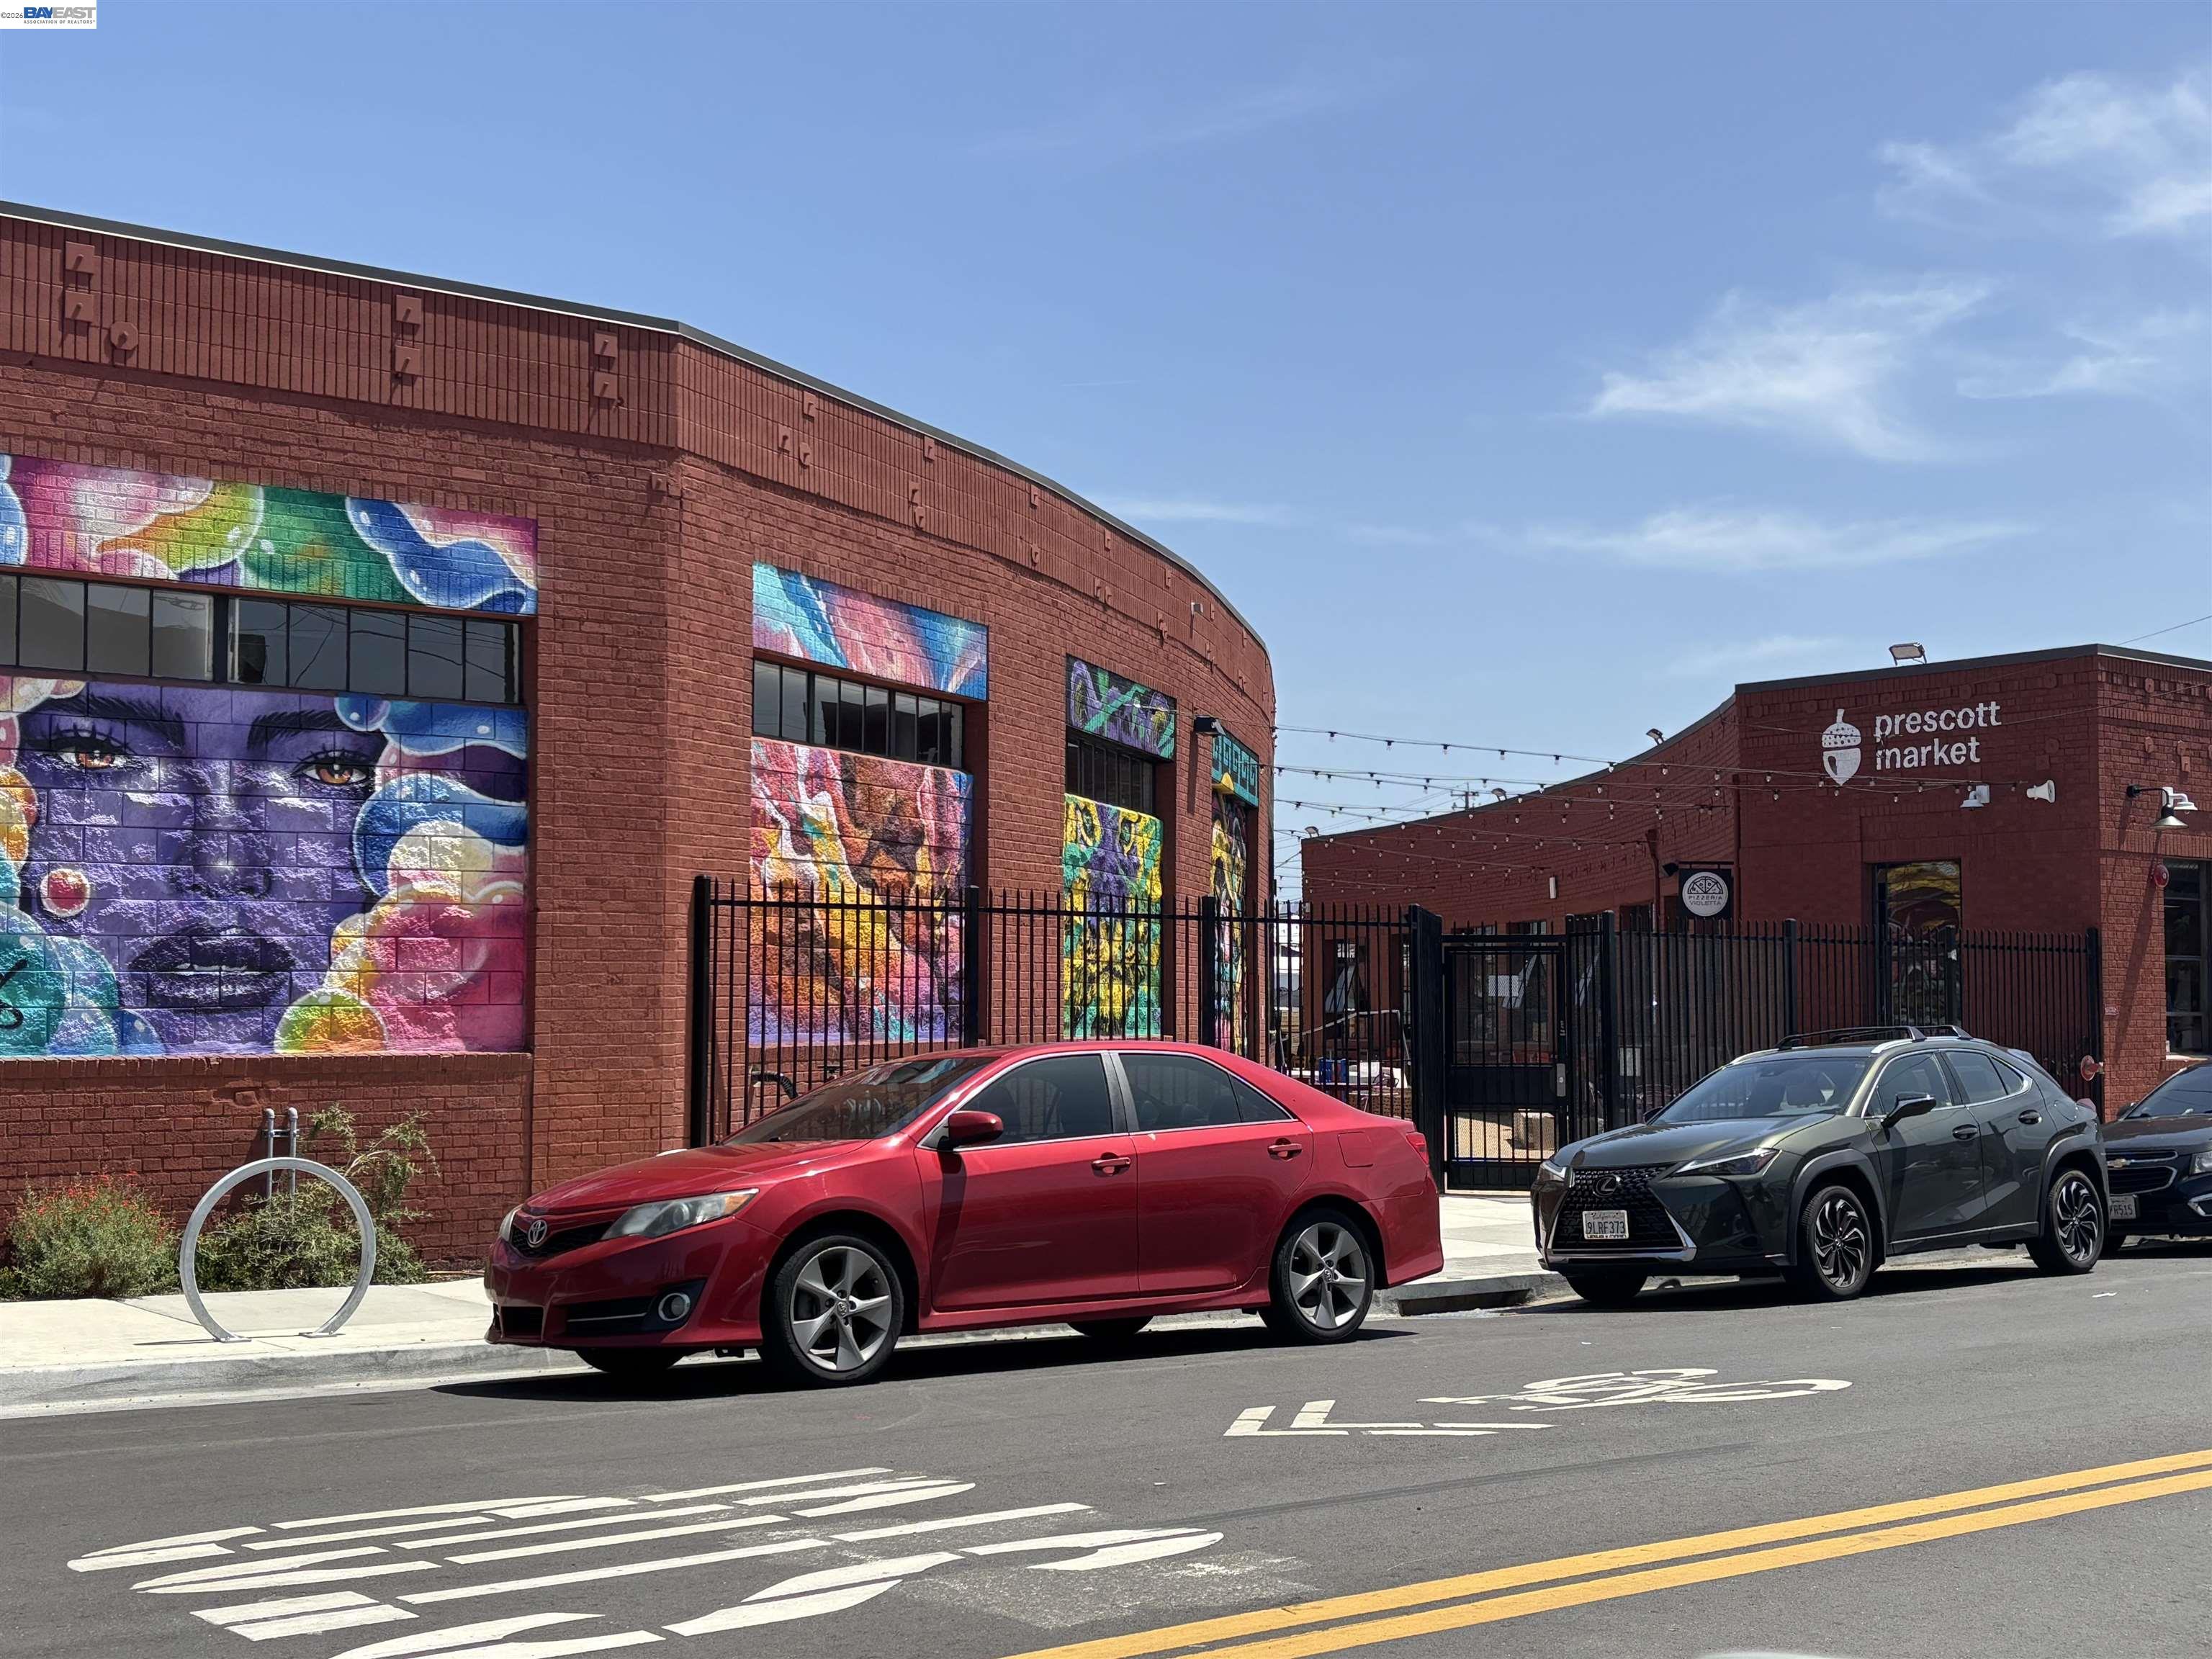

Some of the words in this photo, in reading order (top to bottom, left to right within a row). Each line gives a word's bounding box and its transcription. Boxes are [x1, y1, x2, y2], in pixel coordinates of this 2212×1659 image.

[1875, 701, 2002, 742] prescott
[1876, 736, 1980, 770] market
[66, 1467, 1224, 1659] STOP
